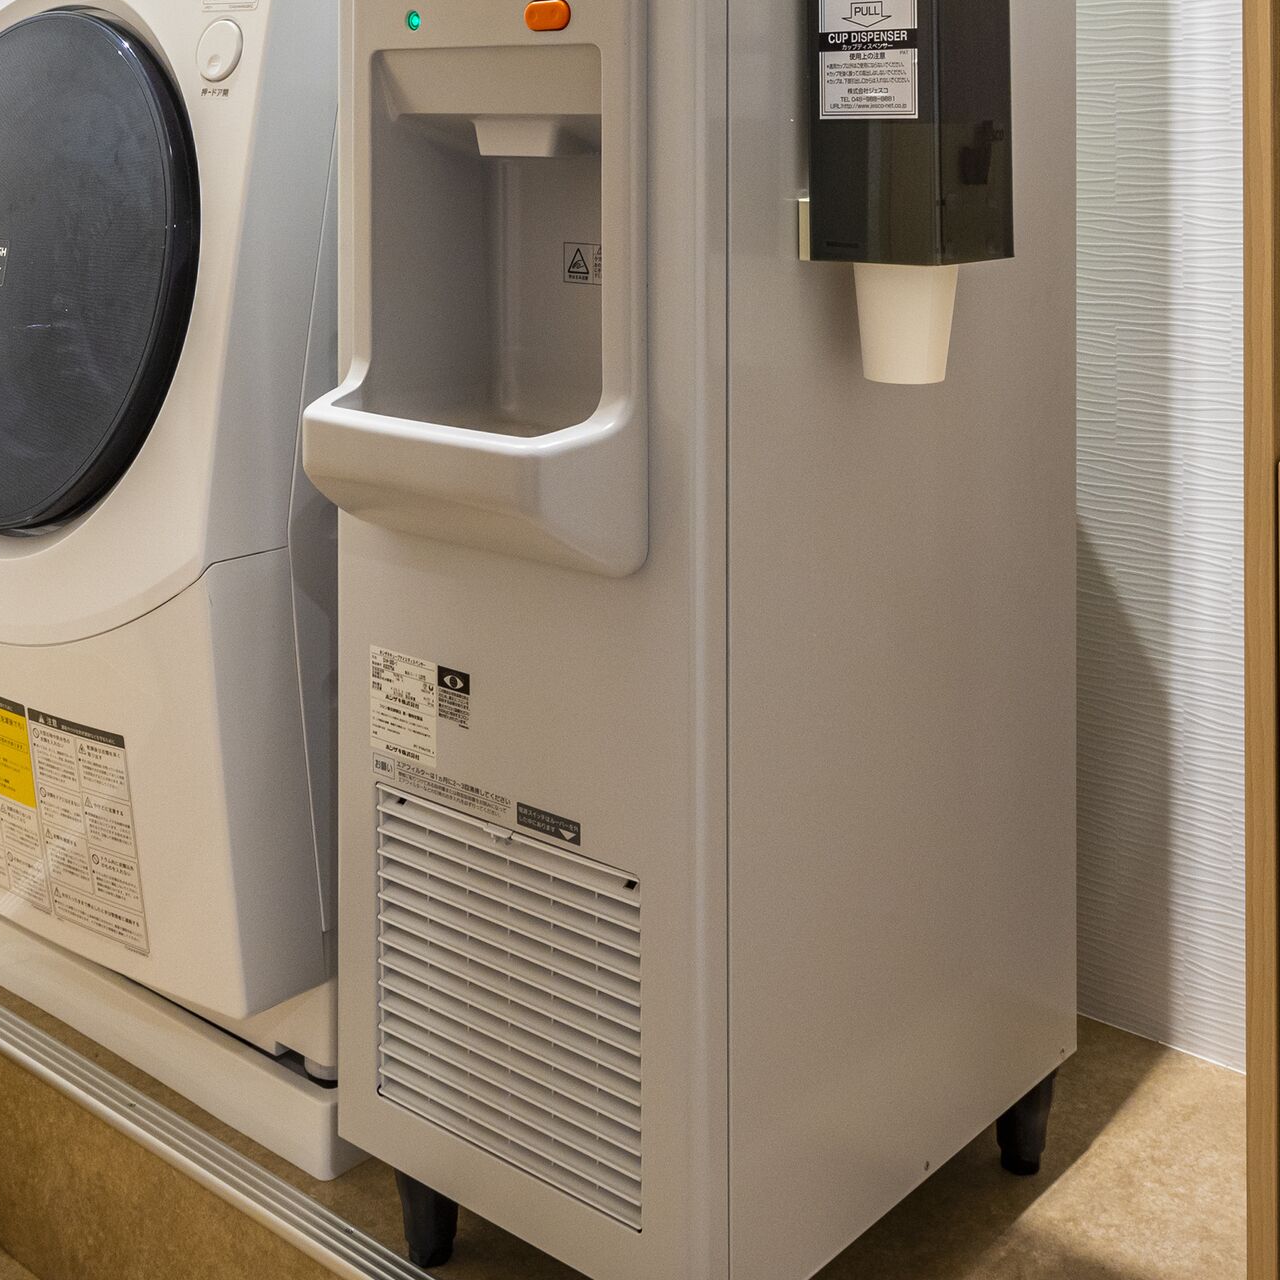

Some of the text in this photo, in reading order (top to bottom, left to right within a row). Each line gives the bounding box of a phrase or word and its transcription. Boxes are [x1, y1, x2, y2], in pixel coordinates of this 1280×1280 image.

[853, 4, 880, 18] PULL
[828, 29, 907, 43] CUP DISPENSER
[841, 42, 892, 50] カップディスペンサー
[849, 52, 885, 60] 使用上の注意
